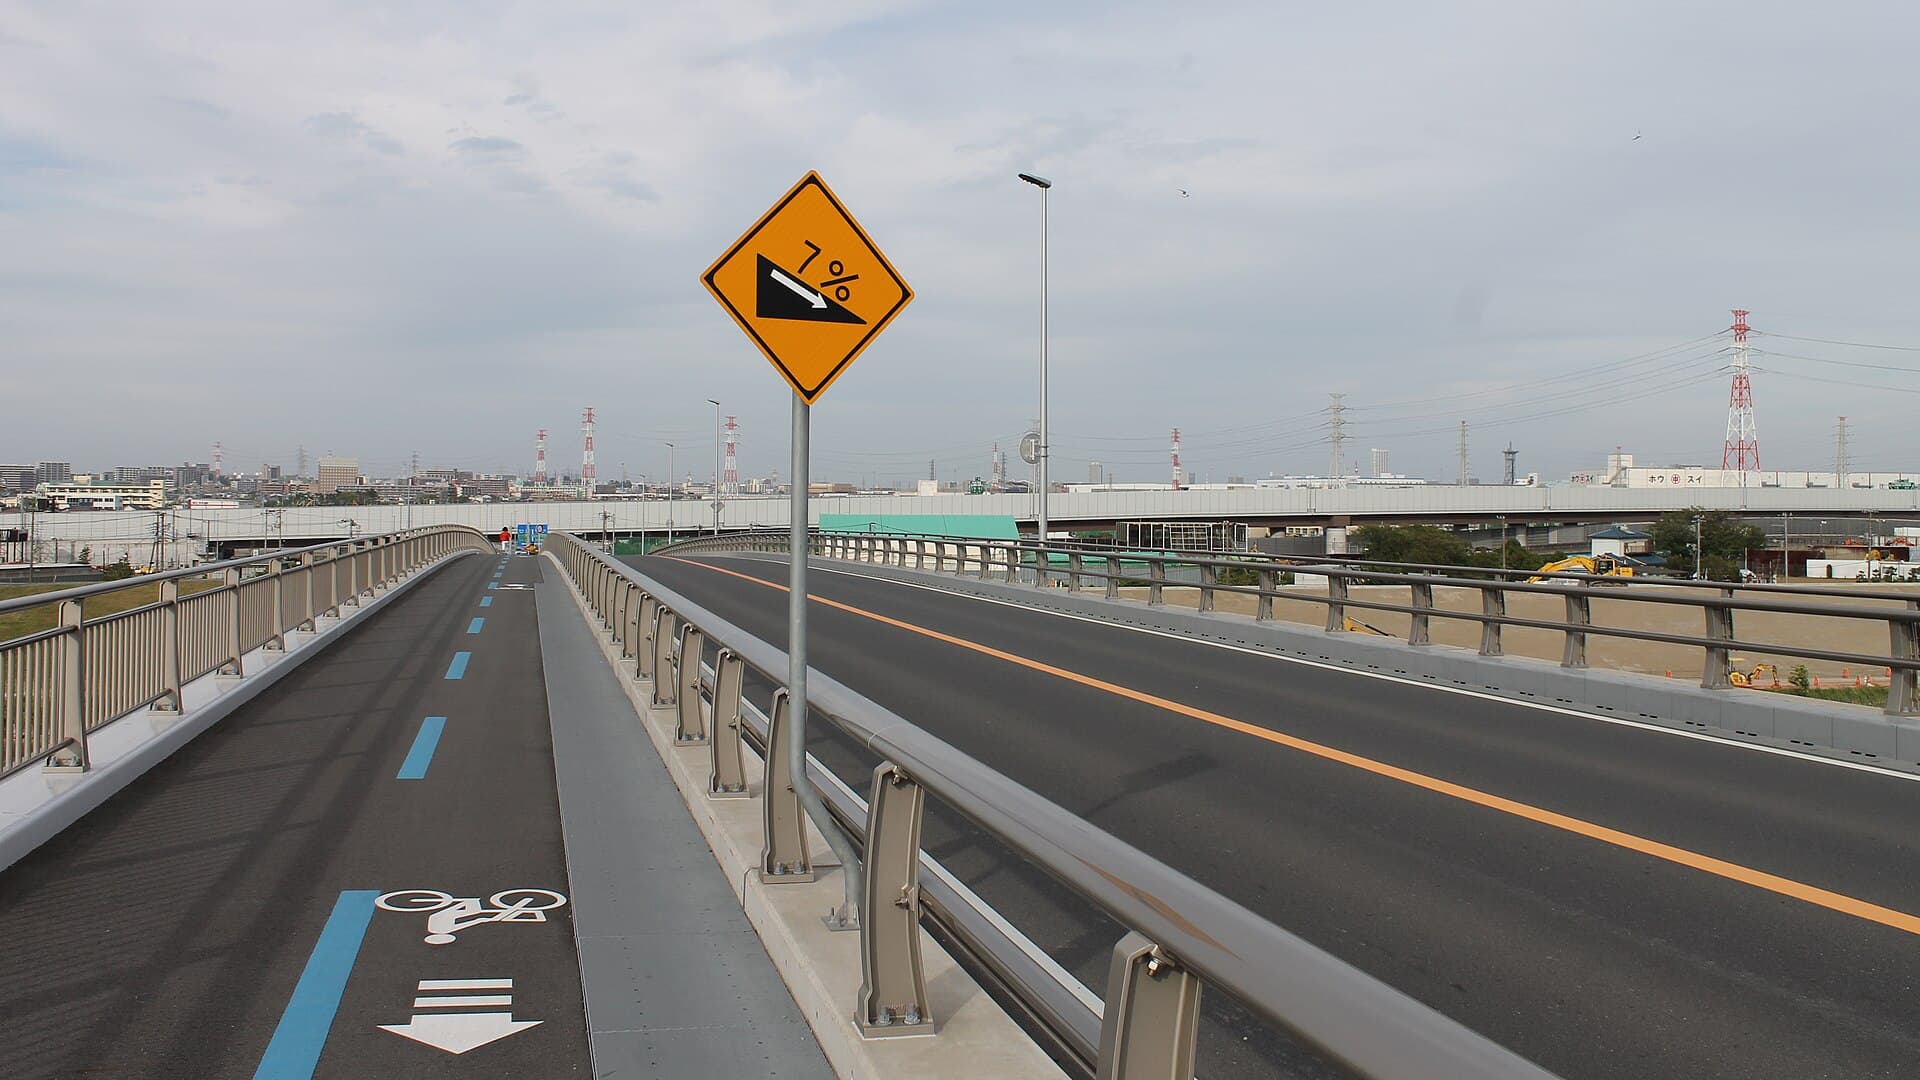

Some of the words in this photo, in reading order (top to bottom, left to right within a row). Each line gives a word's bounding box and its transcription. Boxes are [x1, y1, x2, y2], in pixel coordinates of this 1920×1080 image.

[798, 239, 859, 301] 7%
[1648, 475, 1664, 484] ホウ
[1686, 475, 1702, 484] スイ
